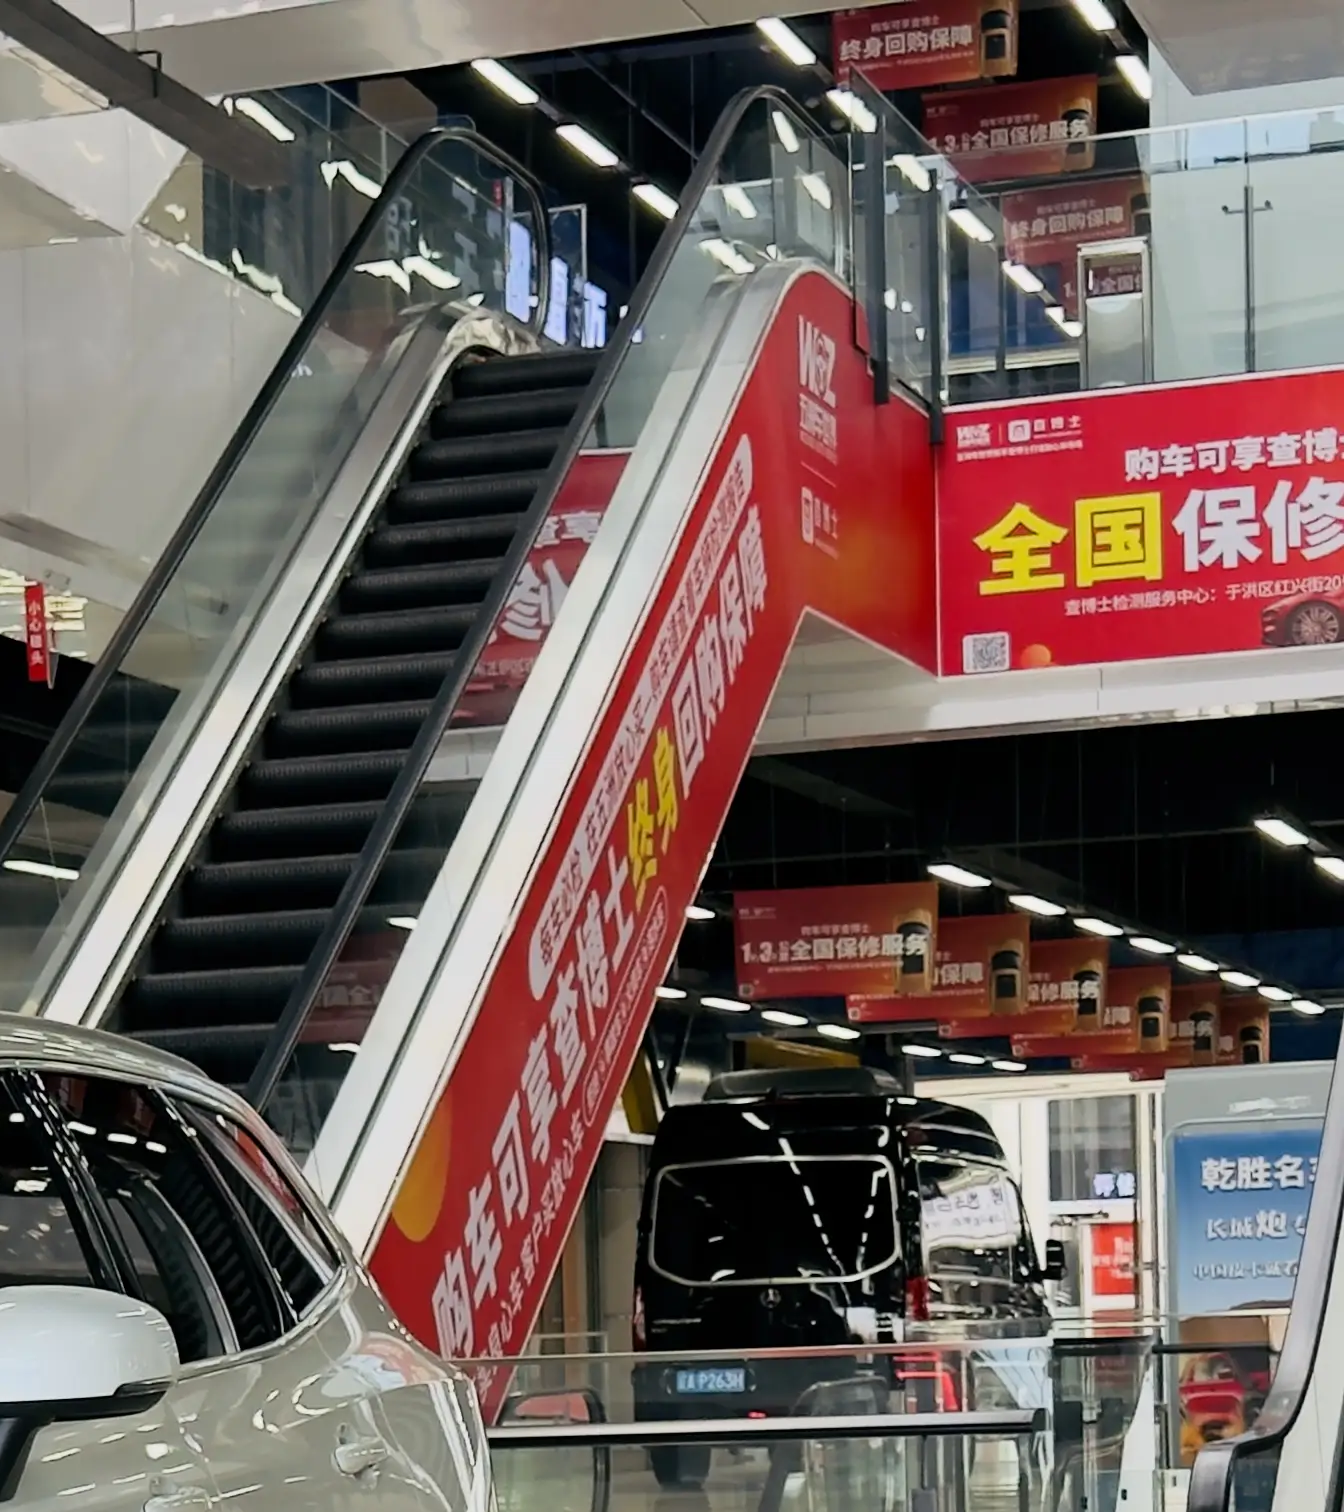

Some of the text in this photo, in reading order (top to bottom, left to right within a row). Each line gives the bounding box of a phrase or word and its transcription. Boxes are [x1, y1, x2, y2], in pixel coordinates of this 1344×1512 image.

[839, 25, 974, 61] 终身回购保障
[1124, 427, 1344, 482] 购车可享查博
